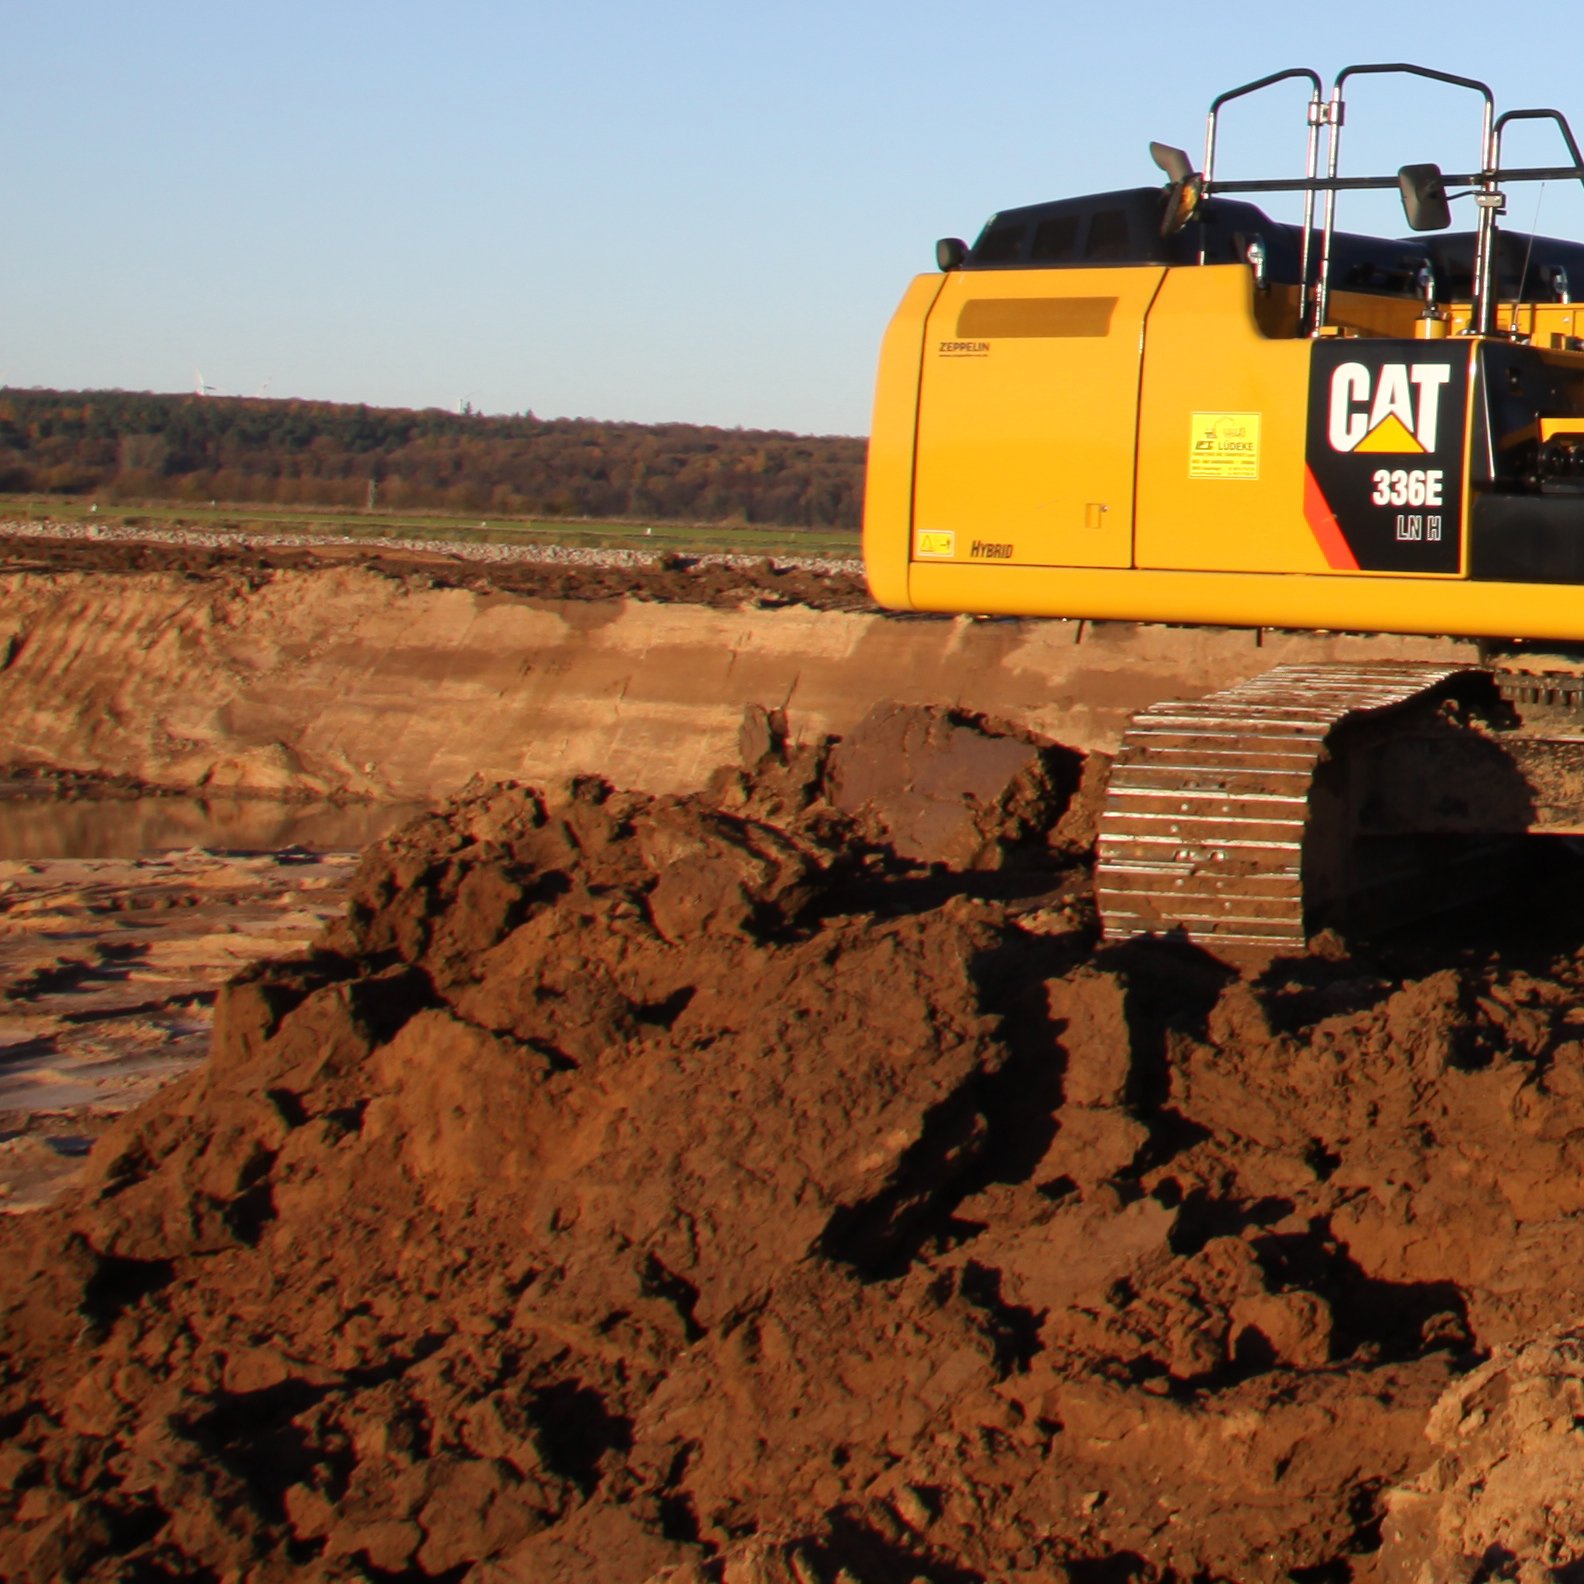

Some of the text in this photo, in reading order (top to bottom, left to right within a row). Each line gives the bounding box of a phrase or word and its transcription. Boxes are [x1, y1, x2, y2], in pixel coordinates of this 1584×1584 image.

[938, 341, 990, 352] ZEPPELIN
[1328, 362, 1451, 454] CAT
[1371, 469, 1444, 507] 336E
[1396, 514, 1442, 542] LN H
